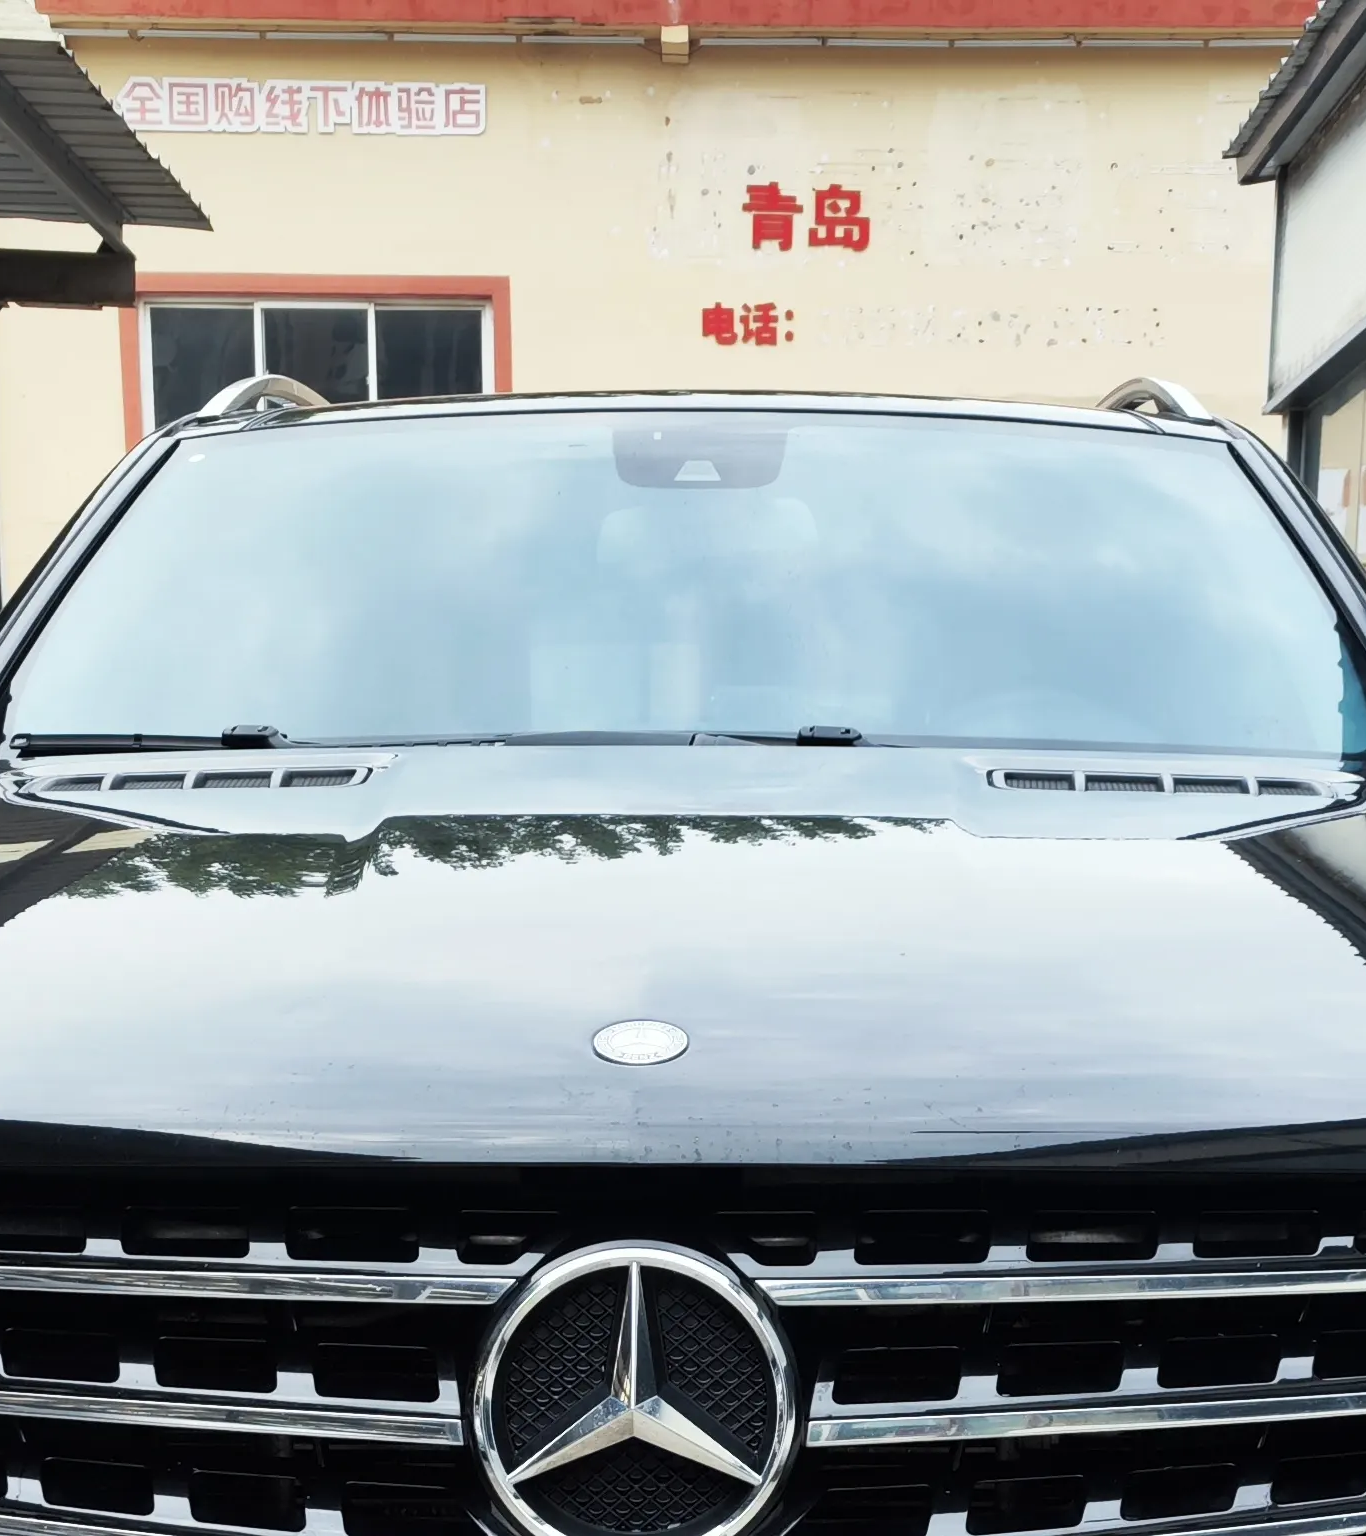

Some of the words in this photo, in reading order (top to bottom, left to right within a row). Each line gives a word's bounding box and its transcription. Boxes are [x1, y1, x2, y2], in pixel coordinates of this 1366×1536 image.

[122, 80, 482, 130] 全国购线下体验店
[742, 181, 871, 252] 青岛
